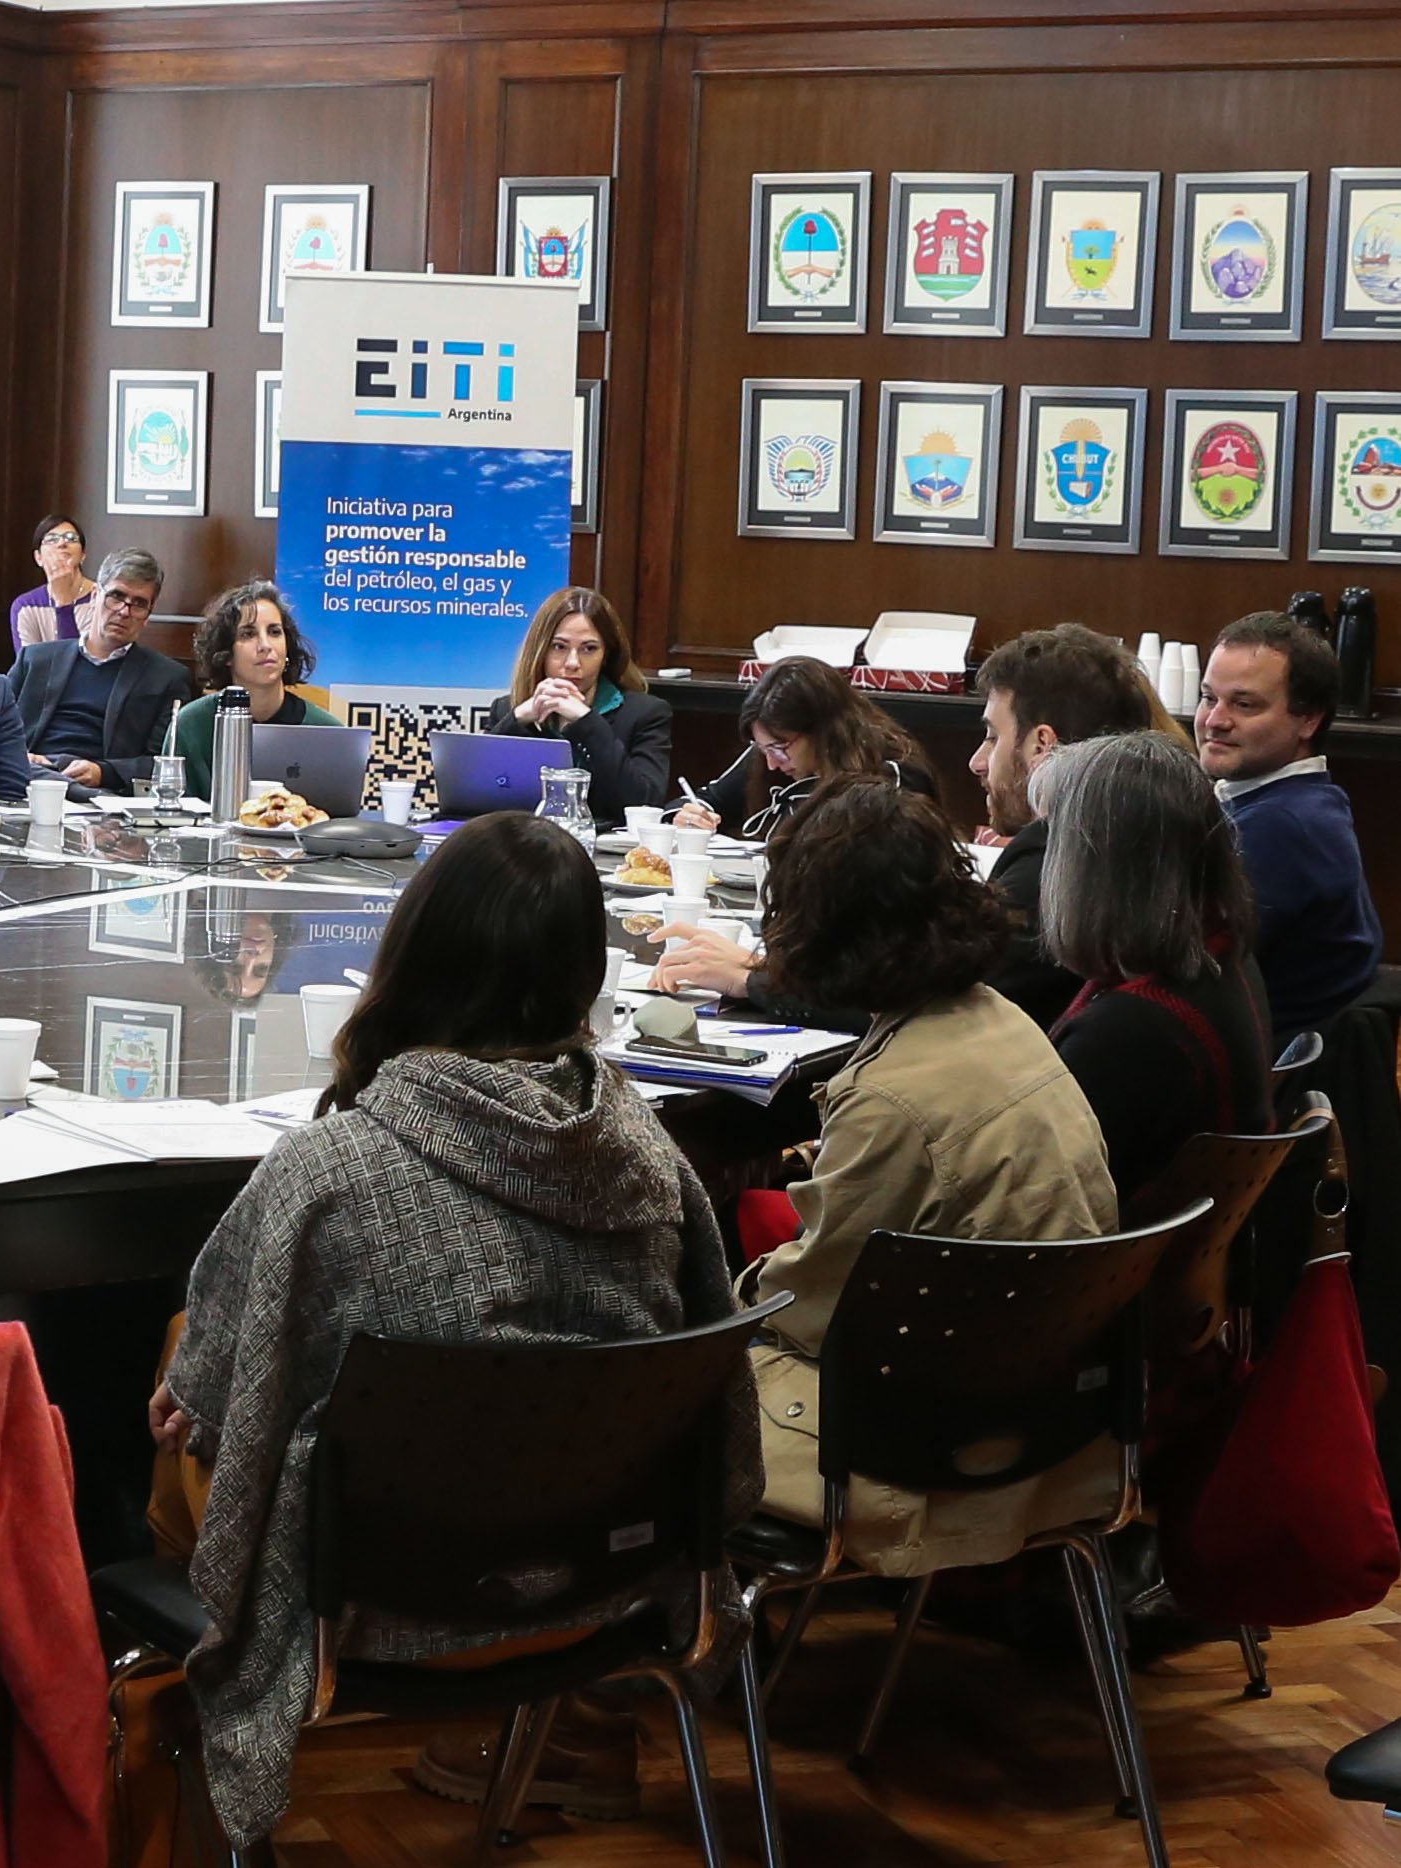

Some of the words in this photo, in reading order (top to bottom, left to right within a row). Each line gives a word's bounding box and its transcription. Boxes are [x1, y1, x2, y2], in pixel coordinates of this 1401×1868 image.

[448, 408, 512, 422] Argentina
[327, 496, 406, 517] Iniciativa
[412, 503, 453, 521] para
[326, 524, 424, 542] promover
[428, 522, 446, 542] la
[325, 545, 399, 567] gestión
[405, 549, 526, 570] responsable
[324, 568, 351, 587] del
[357, 570, 437, 593] petróleo,
[442, 572, 458, 590] el
[463, 577, 496, 596] gas
[500, 579, 512, 597] y
[323, 592, 350, 611] los
[354, 598, 431, 614] recursos
[436, 597, 529, 618] minerales.
